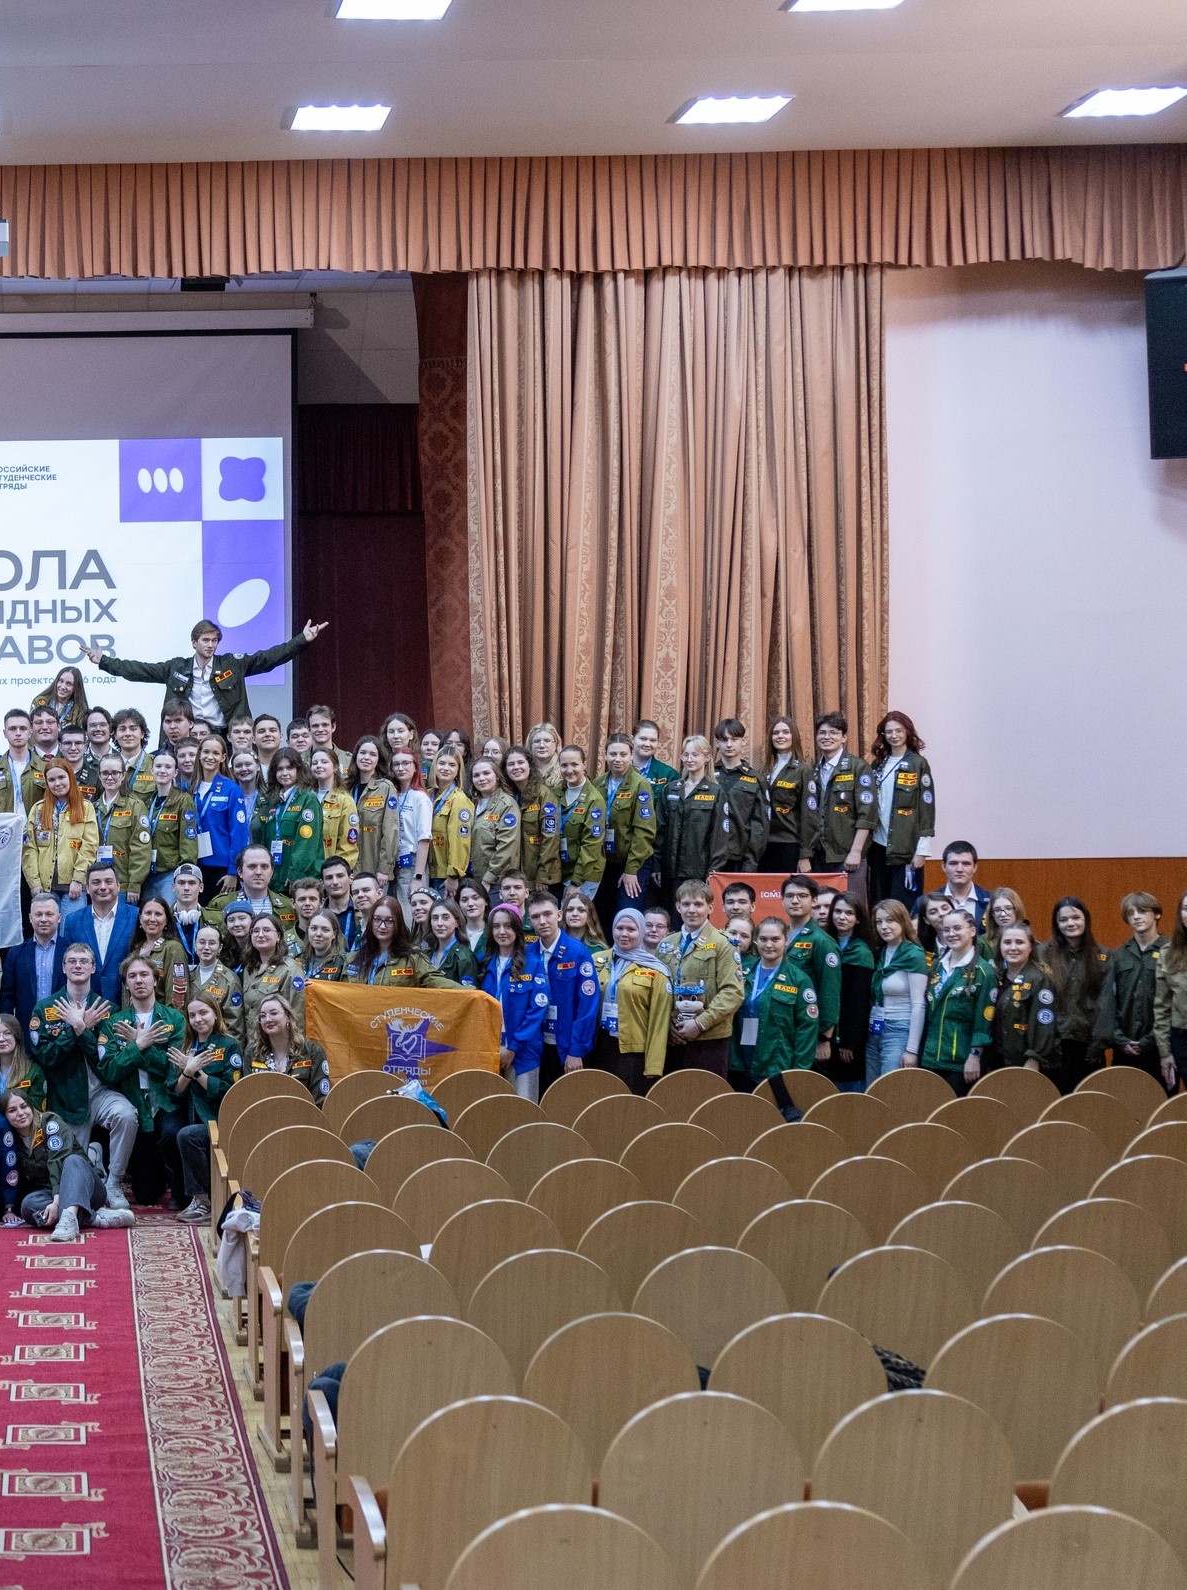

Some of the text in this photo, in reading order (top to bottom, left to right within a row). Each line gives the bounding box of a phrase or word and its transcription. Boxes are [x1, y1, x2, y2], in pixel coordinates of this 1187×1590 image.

[10, 677, 54, 687] проекто
[92, 676, 117, 685] года
[369, 1006, 445, 1032] СТУДЕНЧЕСКИЕ
[382, 1065, 431, 1076] ОТРЯДЫ
